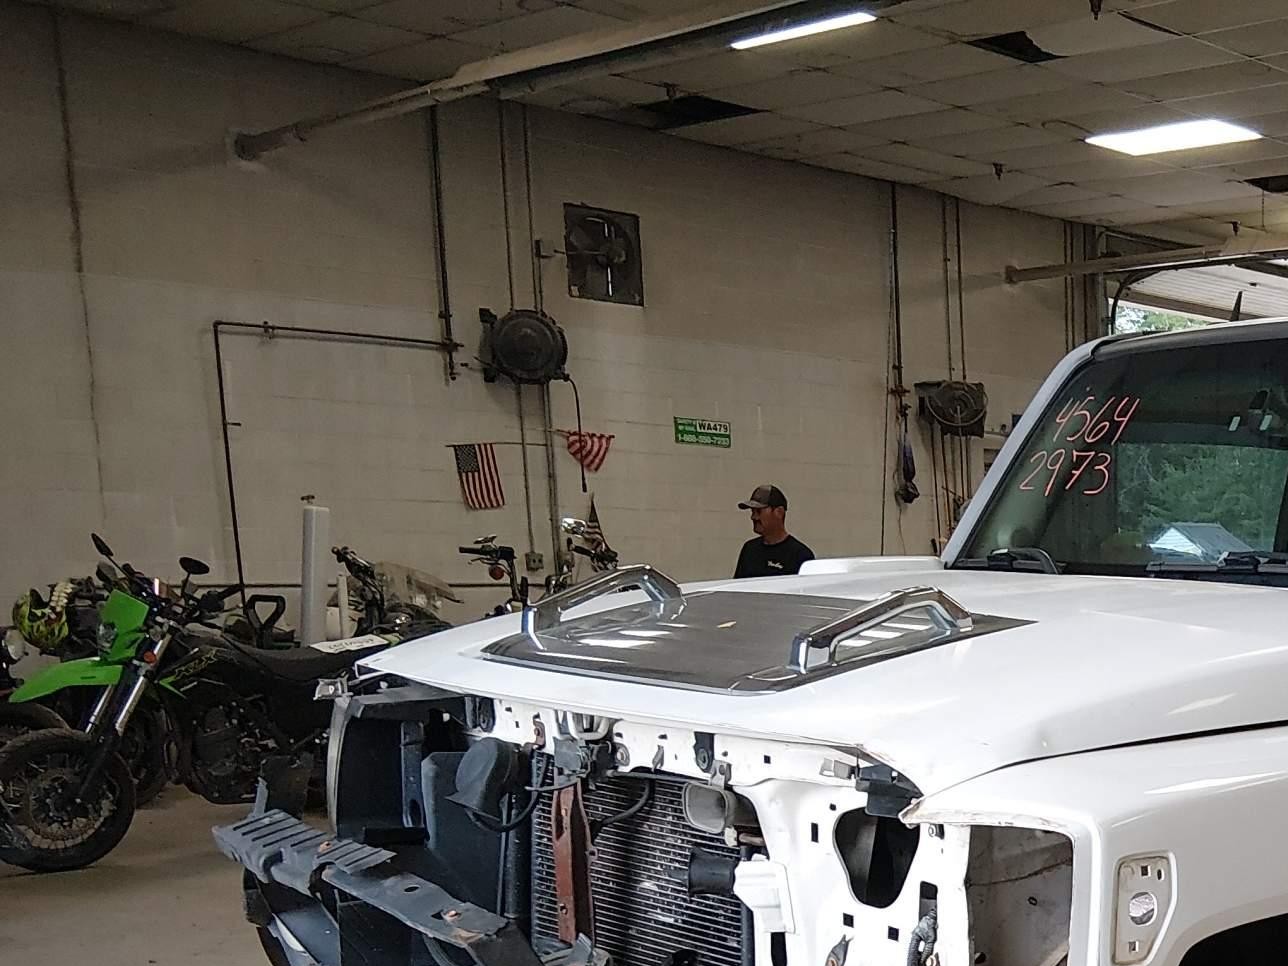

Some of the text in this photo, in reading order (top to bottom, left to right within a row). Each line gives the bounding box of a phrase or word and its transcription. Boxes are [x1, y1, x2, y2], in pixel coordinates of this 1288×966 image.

[698, 422, 729, 433] WA479
[1053, 396, 1140, 446] 4564
[1019, 448, 1112, 497] 2973
